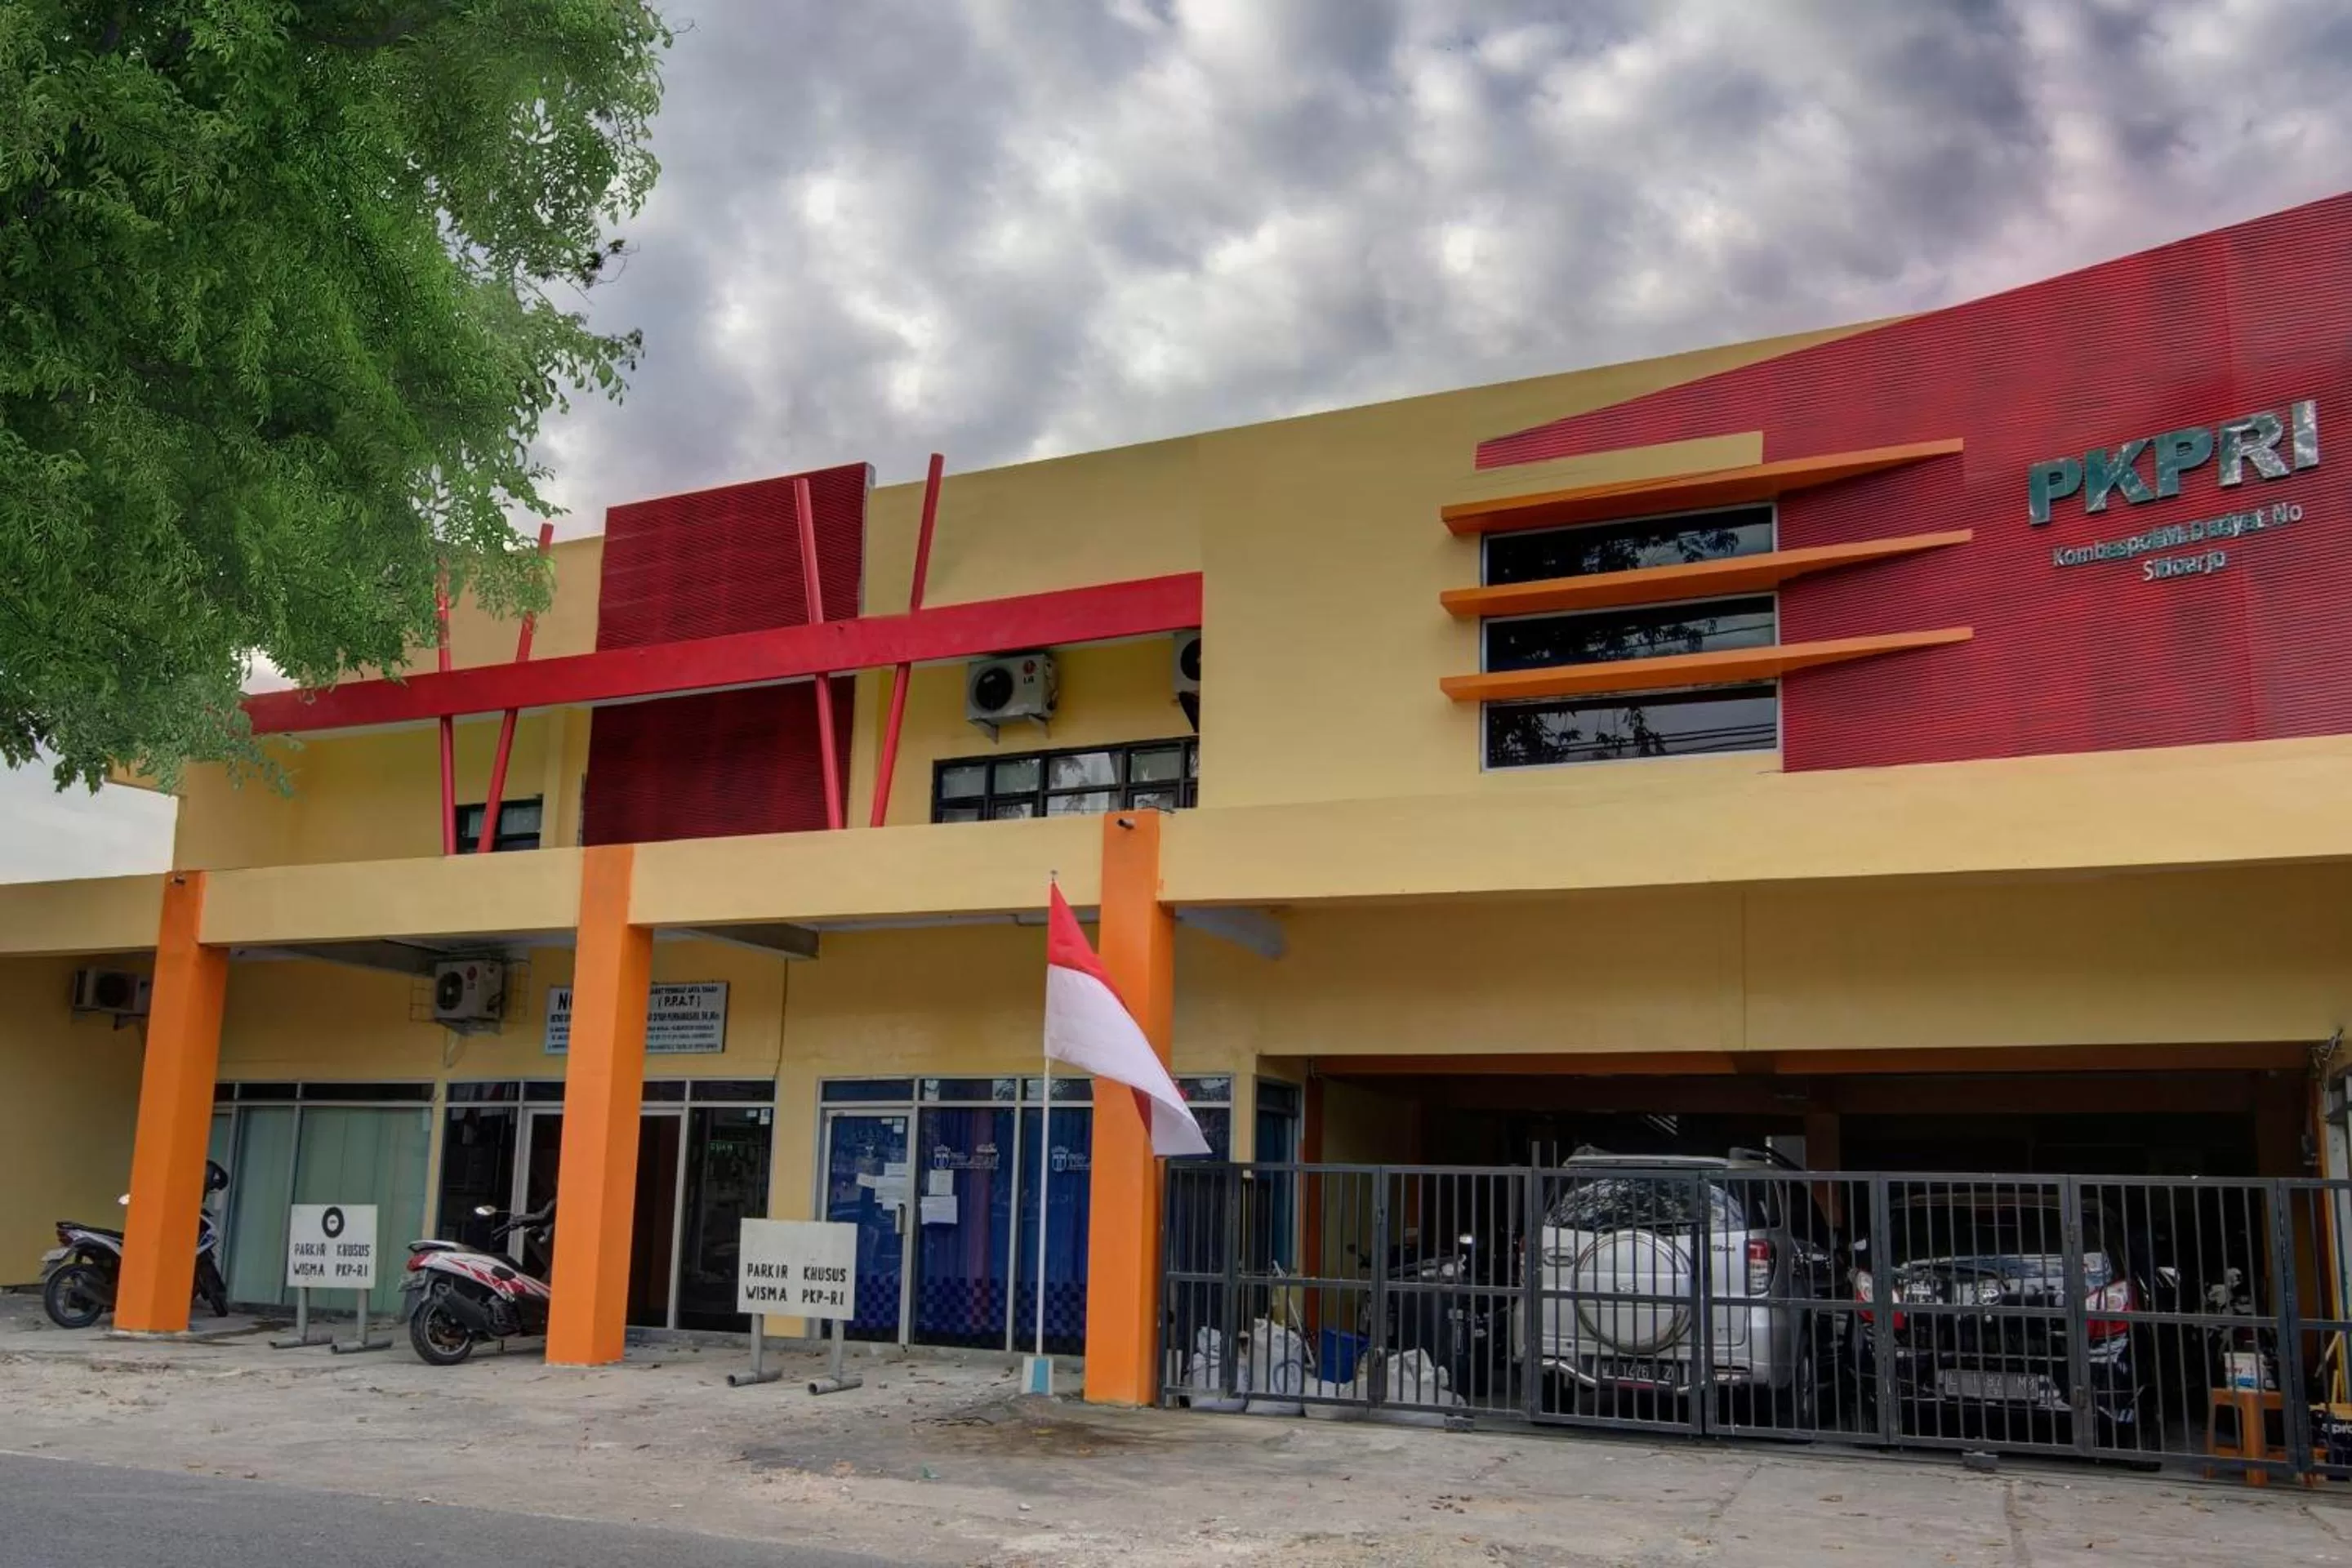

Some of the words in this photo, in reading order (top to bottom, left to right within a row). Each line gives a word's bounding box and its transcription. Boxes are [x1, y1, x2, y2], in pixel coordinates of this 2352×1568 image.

[2029, 399, 2319, 525] PKPRI
[746, 1263, 789, 1280] PARKIR
[803, 1266, 847, 1283] KHUSUS
[745, 1285, 788, 1303] WISMA
[801, 1289, 844, 1306] PKP-RI
